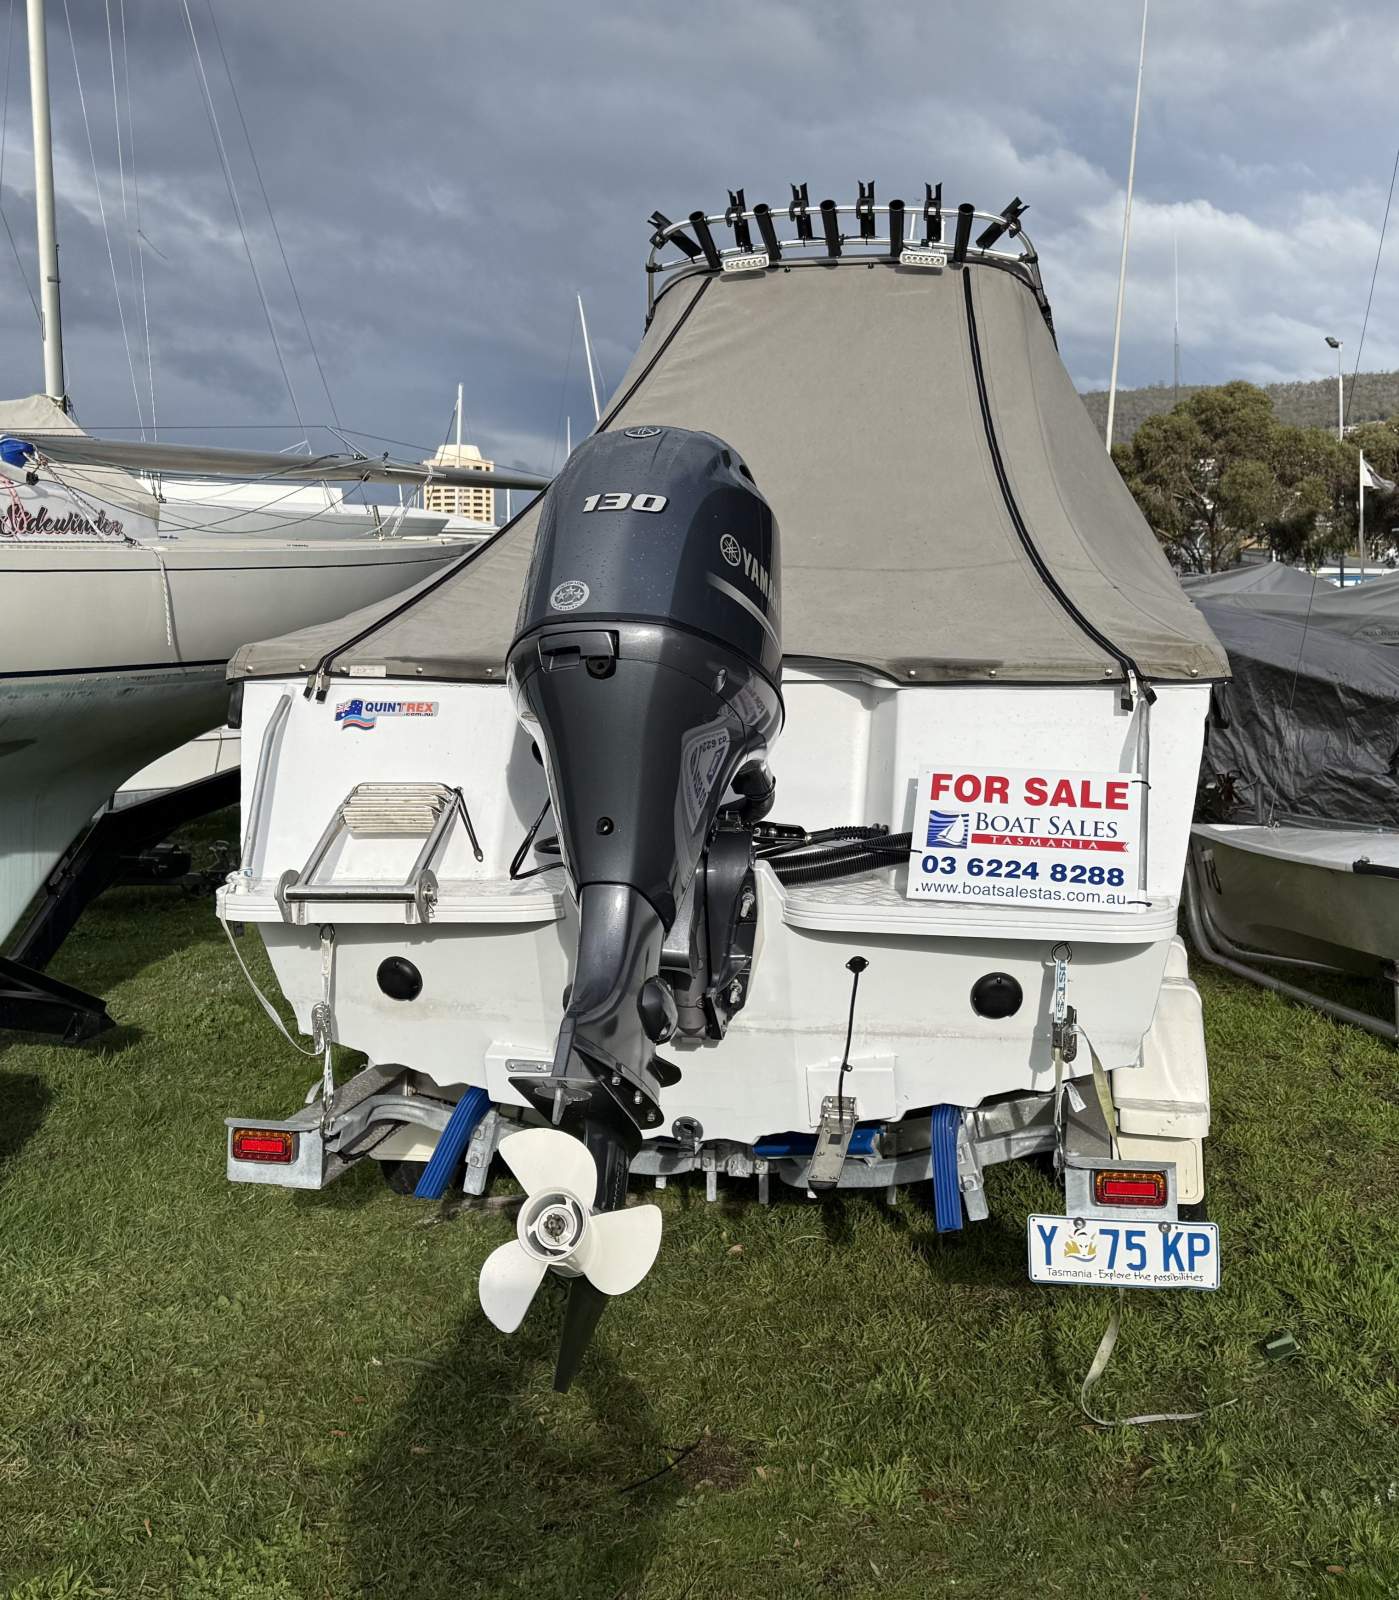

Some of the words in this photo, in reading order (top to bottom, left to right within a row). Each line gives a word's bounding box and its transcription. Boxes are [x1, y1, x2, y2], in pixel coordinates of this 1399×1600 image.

[582, 492, 668, 513] 130
[365, 702, 433, 713] QUINTREX
[930, 773, 1010, 804] FOR
[1023, 777, 1130, 810] SALE
[991, 835, 1099, 850] TASMANIA
[921, 855, 956, 874] 03
[966, 857, 1039, 880] 6224
[1050, 863, 1125, 887] 8288
[921, 881, 1126, 905] www.boatsalestas.com.au
[1037, 1225, 1058, 1266] Y
[1099, 1229, 1147, 1271] 75
[1163, 1231, 1210, 1273] KP
[1047, 1267, 1092, 1278] Tasmania
[1098, 1269, 1132, 1280] Explore
[1134, 1272, 1151, 1281] the
[1153, 1273, 1204, 1282] possibilities
